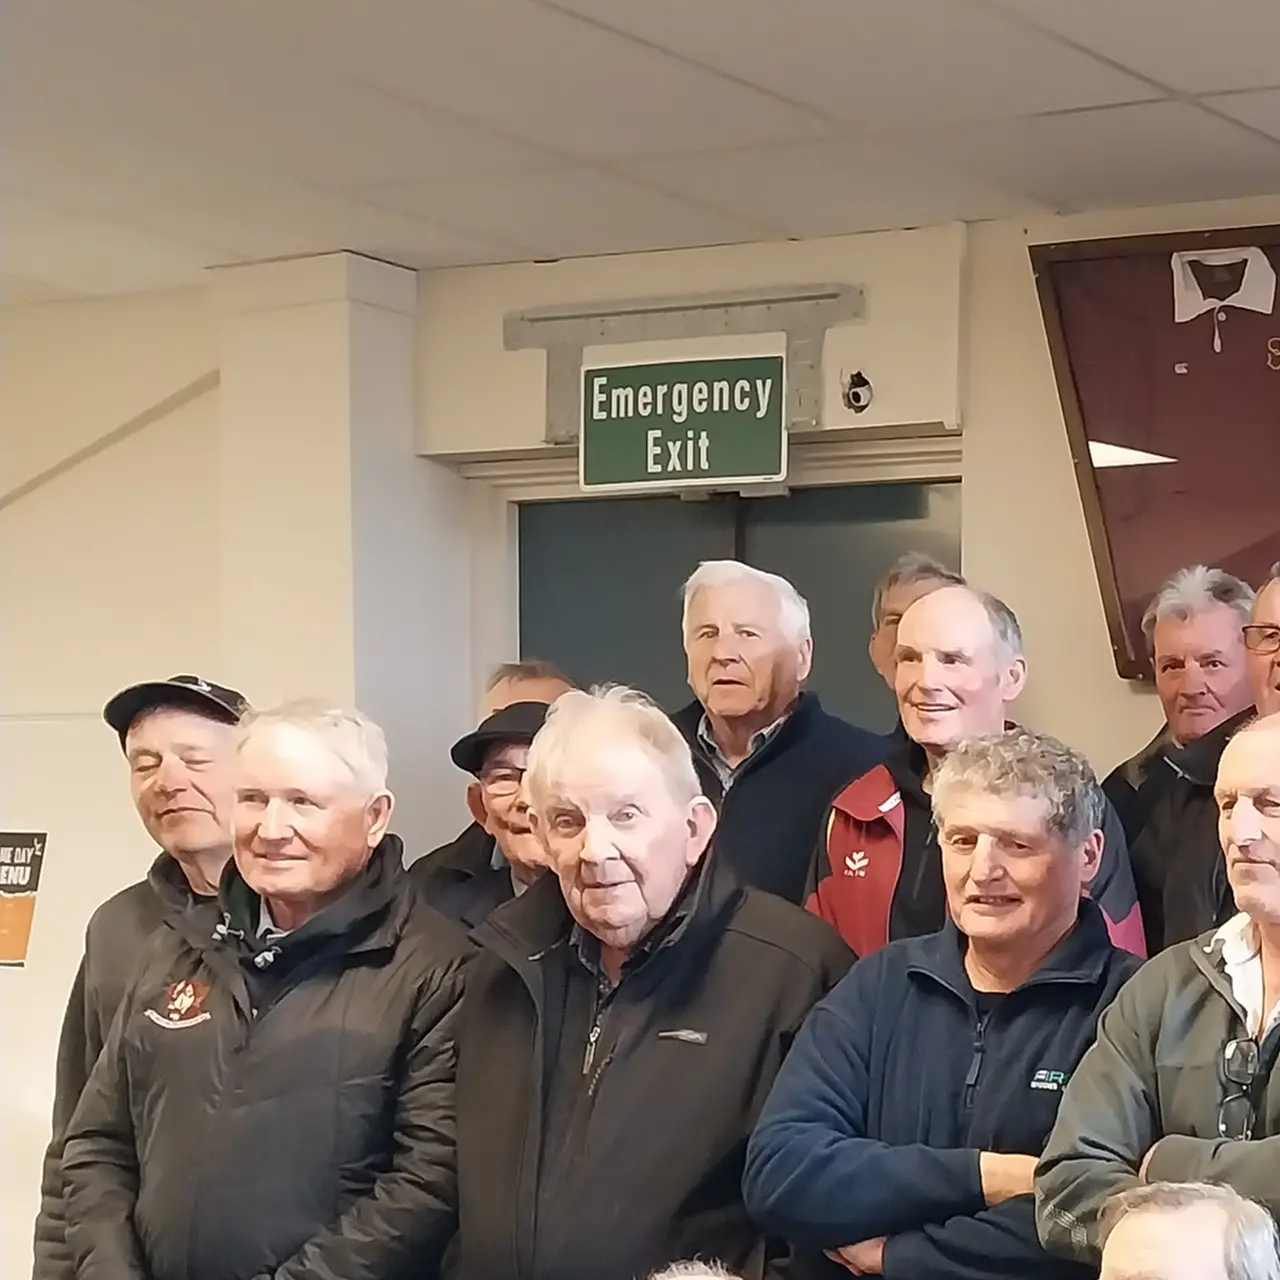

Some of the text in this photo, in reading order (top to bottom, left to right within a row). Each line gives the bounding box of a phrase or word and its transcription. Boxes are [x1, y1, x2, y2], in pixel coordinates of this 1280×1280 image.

[592, 376, 772, 423] Emergency
[647, 429, 709, 473] Exit
[14, 847, 35, 864] DAY
